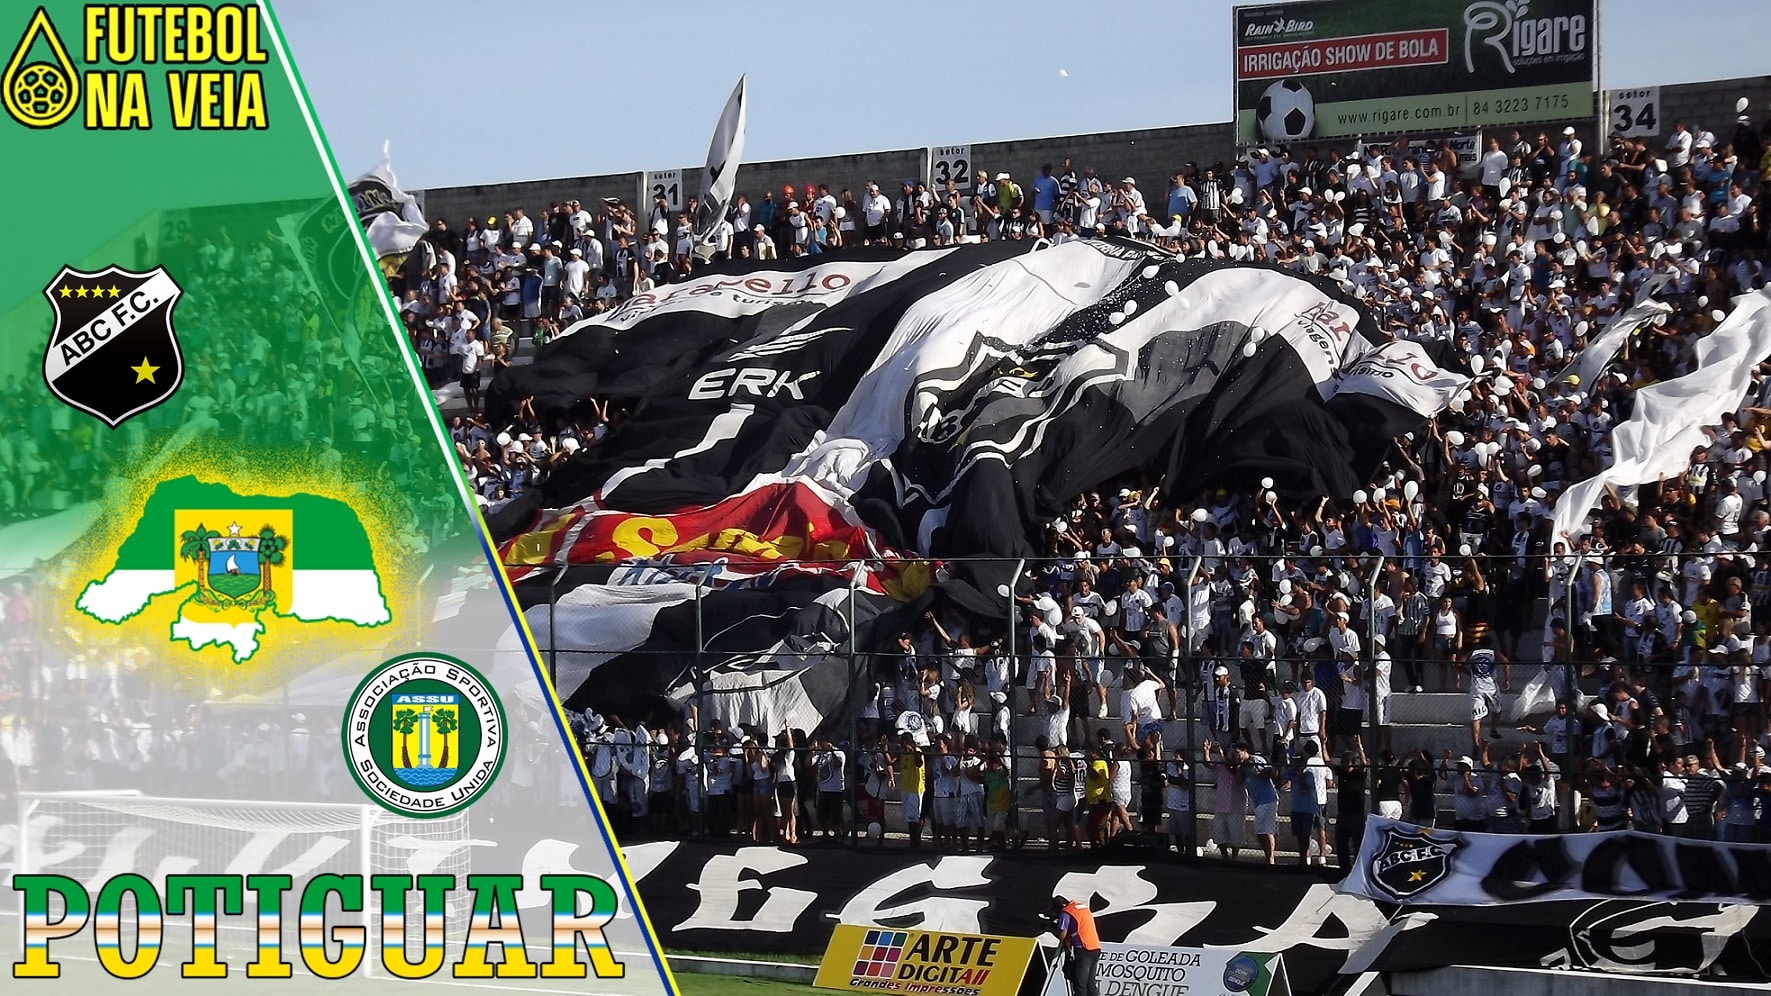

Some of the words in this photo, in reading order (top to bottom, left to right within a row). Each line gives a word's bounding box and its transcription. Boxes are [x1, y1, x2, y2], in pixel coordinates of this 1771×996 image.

[1245, 23, 1274, 37] RAIN
[1285, 19, 1313, 33] BIRD
[1463, 0, 1586, 74] Rigare
[1244, 46, 1321, 73] IRRIGAÇÃO
[1326, 44, 1370, 66] SHOW
[1375, 41, 1394, 60] DE
[1399, 37, 1439, 58] BOLA
[1618, 89, 1650, 99] setor
[1338, 103, 1460, 125] www.rigare.com.br
[1473, 102, 1489, 116] 84
[1495, 98, 1529, 114] 3223
[1535, 94, 1569, 110] 7175
[1613, 102, 1657, 133] 34
[940, 147, 964, 156] setor
[654, 172, 676, 180] setor
[935, 159, 969, 184] 32
[1378, 851, 1412, 872] ABC
[905, 934, 1001, 967] ARTE
[1111, 953, 1124, 962] DE
[1125, 950, 1201, 966] GOLEADA
[1096, 963, 1186, 982] MOSQUITO
[850, 977, 901, 990] Grandes
[904, 982, 980, 996] Impressões
[1105, 979, 1189, 996] DENGUE
